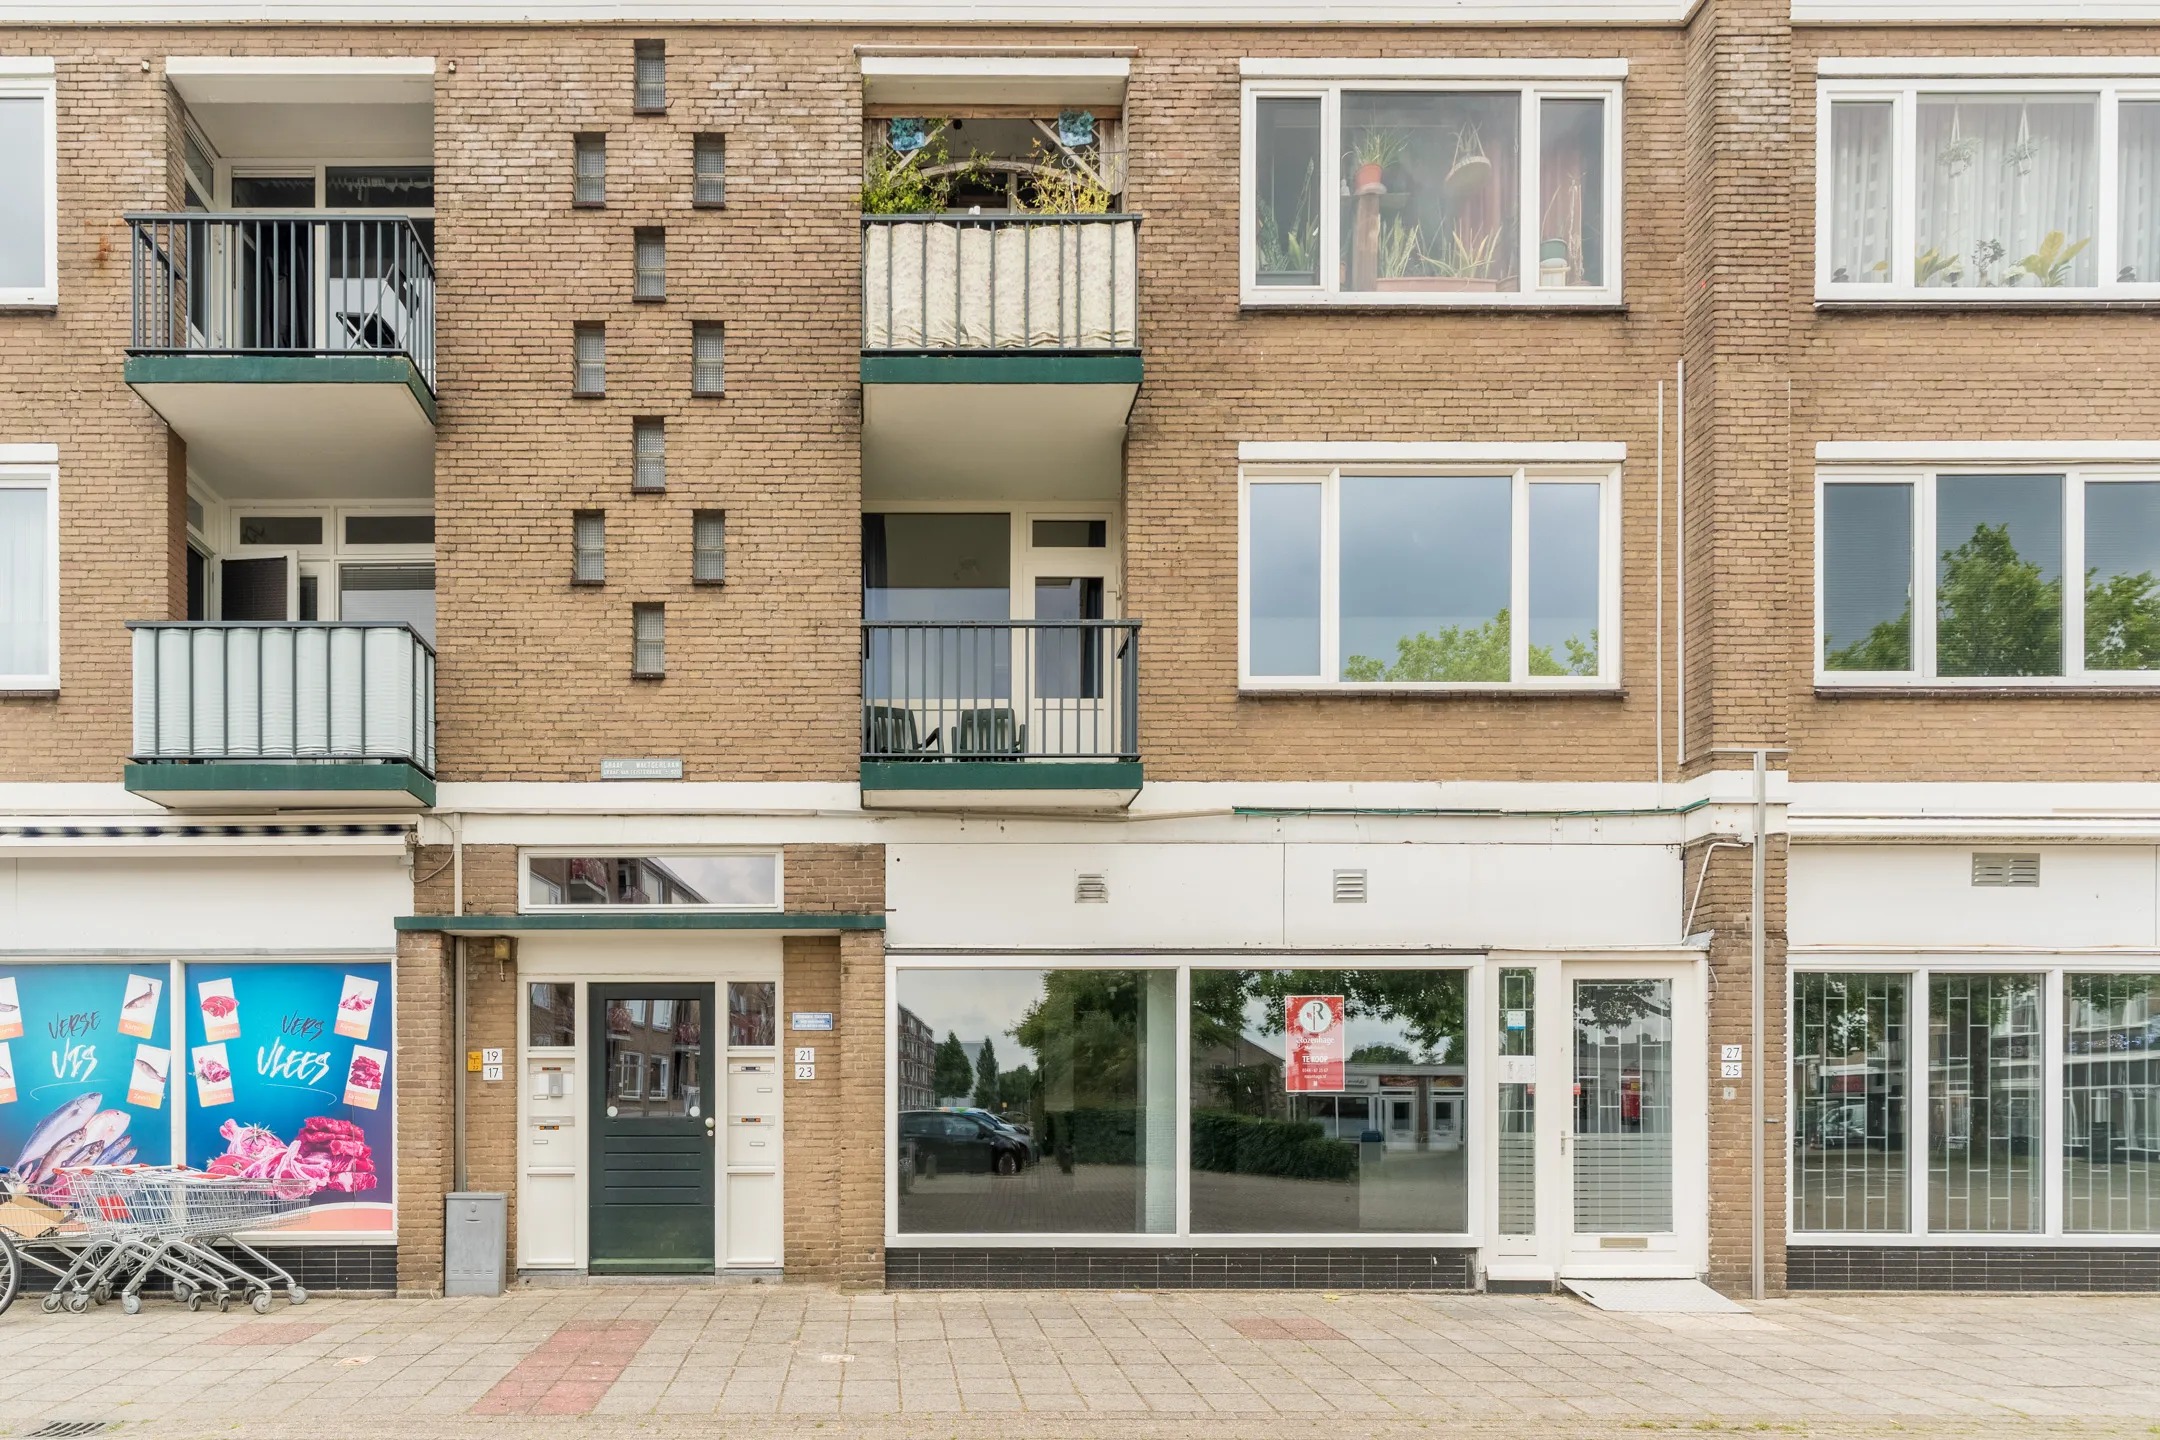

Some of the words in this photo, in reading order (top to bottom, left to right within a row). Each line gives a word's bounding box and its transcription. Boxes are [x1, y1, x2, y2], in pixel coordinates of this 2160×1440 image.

[48, 1011, 101, 1039] VERSE
[282, 1010, 324, 1041] VERS
[487, 1051, 498, 1061] 19
[800, 1050, 811, 1061] 21
[1302, 1055, 1310, 1063] TE
[1311, 1055, 1329, 1063] KOOP
[1726, 1047, 1740, 1059] 27
[51, 1037, 98, 1082] VIS
[257, 1036, 331, 1085] VLEES
[489, 1067, 499, 1078] 17
[799, 1067, 812, 1077] 23
[1725, 1064, 1740, 1076] 25
